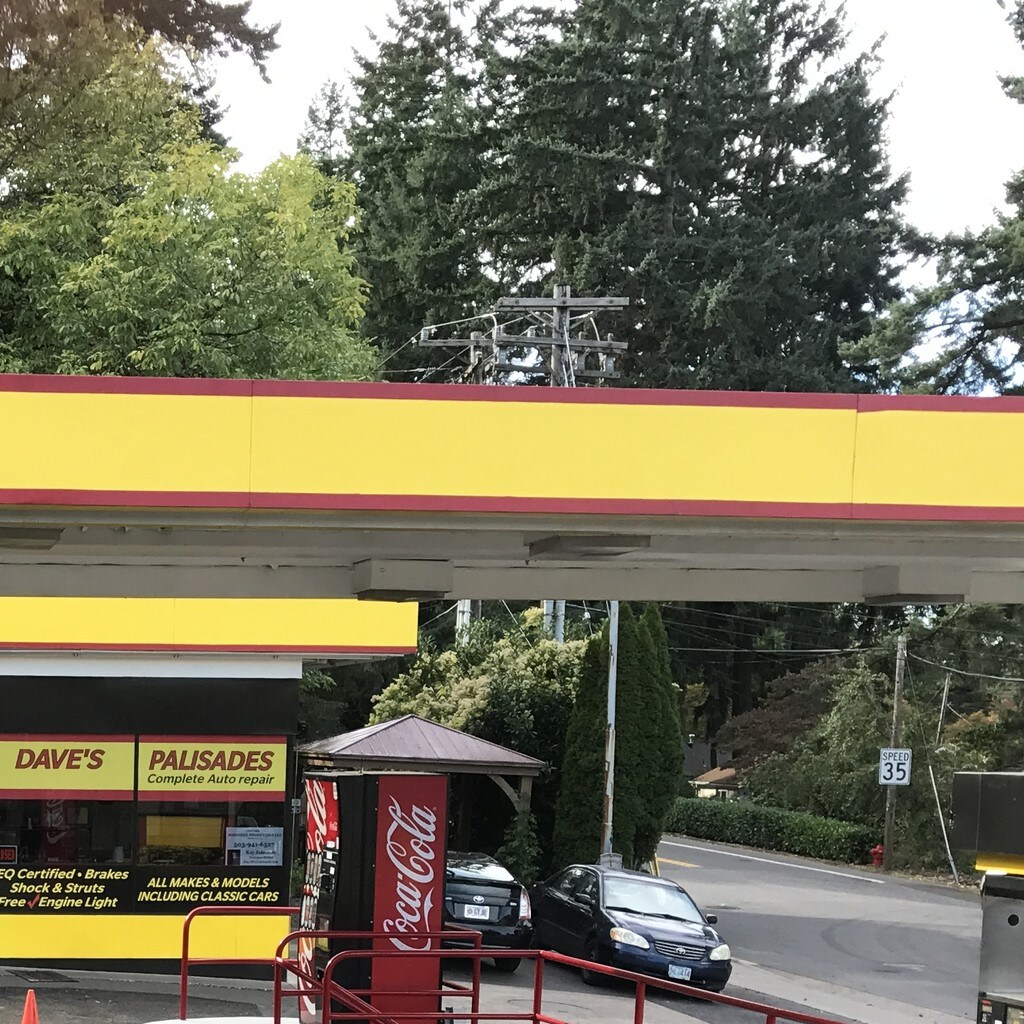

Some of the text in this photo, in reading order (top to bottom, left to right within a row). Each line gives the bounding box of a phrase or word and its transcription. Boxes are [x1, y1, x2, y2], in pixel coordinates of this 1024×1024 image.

[15, 748, 106, 770] DAVE'S
[148, 750, 275, 771] PALISADES
[882, 752, 910, 761] SPEED
[883, 762, 906, 781] 35
[147, 774, 275, 786] Complete Auto repair
[17, 868, 77, 879] Certified
[84, 868, 130, 880] Brakes
[9, 882, 106, 893] Shock & Struts
[147, 877, 270, 888] ALL MAKES & MODELS
[38, 896, 83, 909] Engine
[84, 897, 119, 909] Light
[137, 891, 280, 902] INCLUDING CLASSIC CARS
